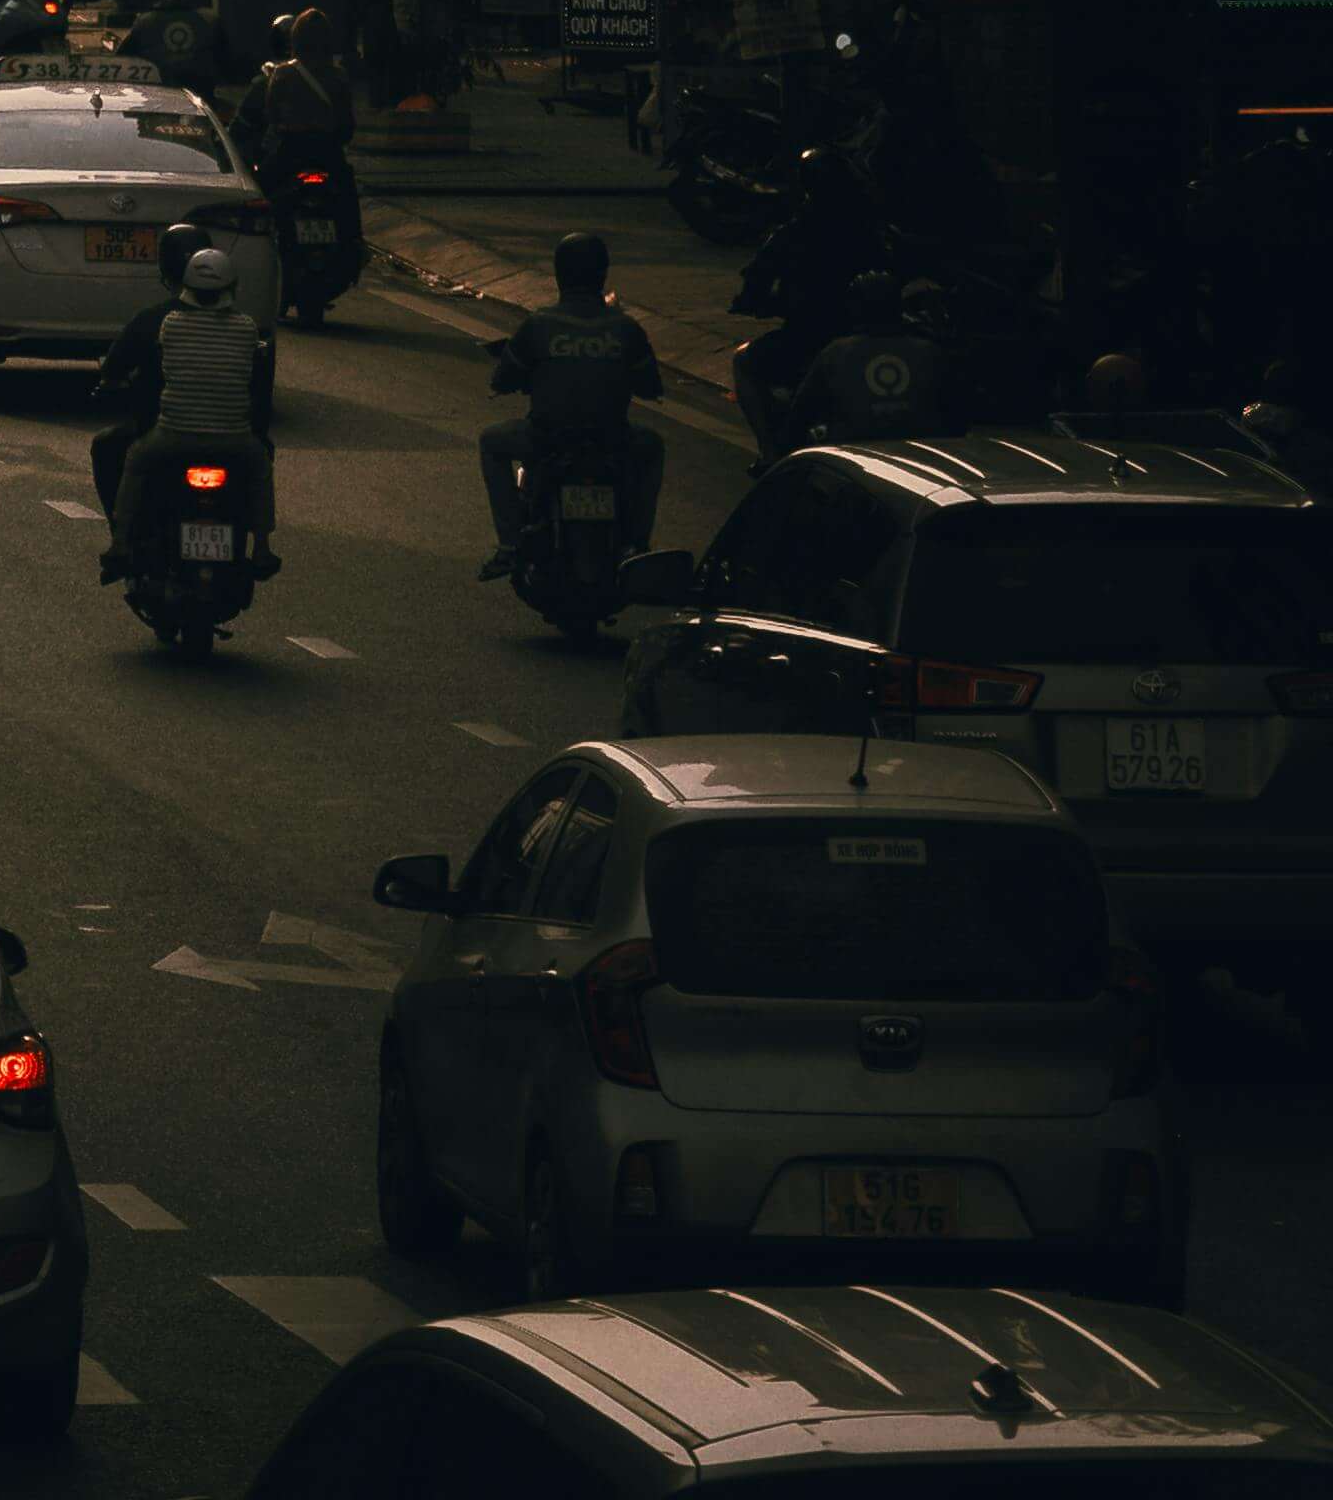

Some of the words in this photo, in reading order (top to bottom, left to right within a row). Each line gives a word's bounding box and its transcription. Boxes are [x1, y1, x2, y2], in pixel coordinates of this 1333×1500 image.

[601, 15, 649, 37] KHÁCH
[98, 64, 122, 82] 27
[128, 64, 152, 83] 27
[549, 331, 623, 358] Grab
[1130, 723, 1181, 753] 61A
